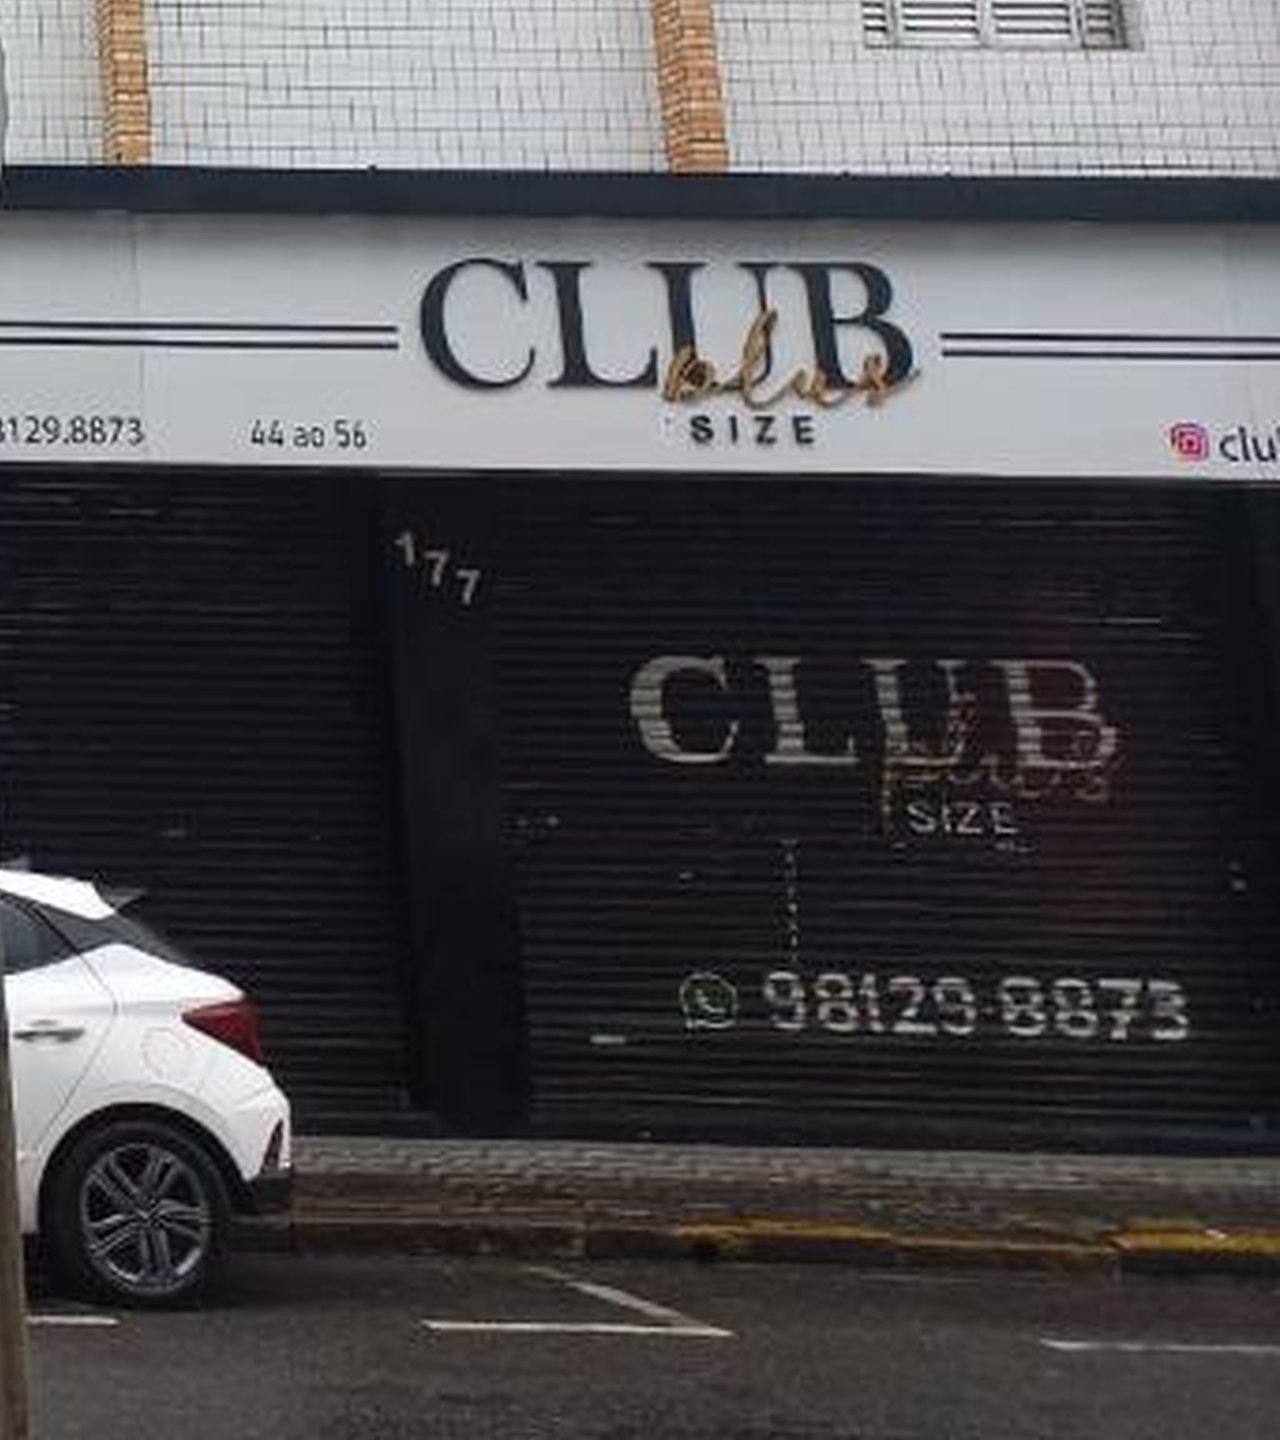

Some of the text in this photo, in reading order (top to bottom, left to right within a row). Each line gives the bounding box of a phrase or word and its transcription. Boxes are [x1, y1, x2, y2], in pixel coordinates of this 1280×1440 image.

[419, 257, 916, 392] CLUB
[250, 418, 367, 449] 44 ao 56
[689, 415, 815, 446] SIZE
[1218, 425, 1280, 463] clu
[393, 530, 481, 606] 177
[628, 654, 1120, 767] CLUB
[906, 798, 1023, 836] SIZE
